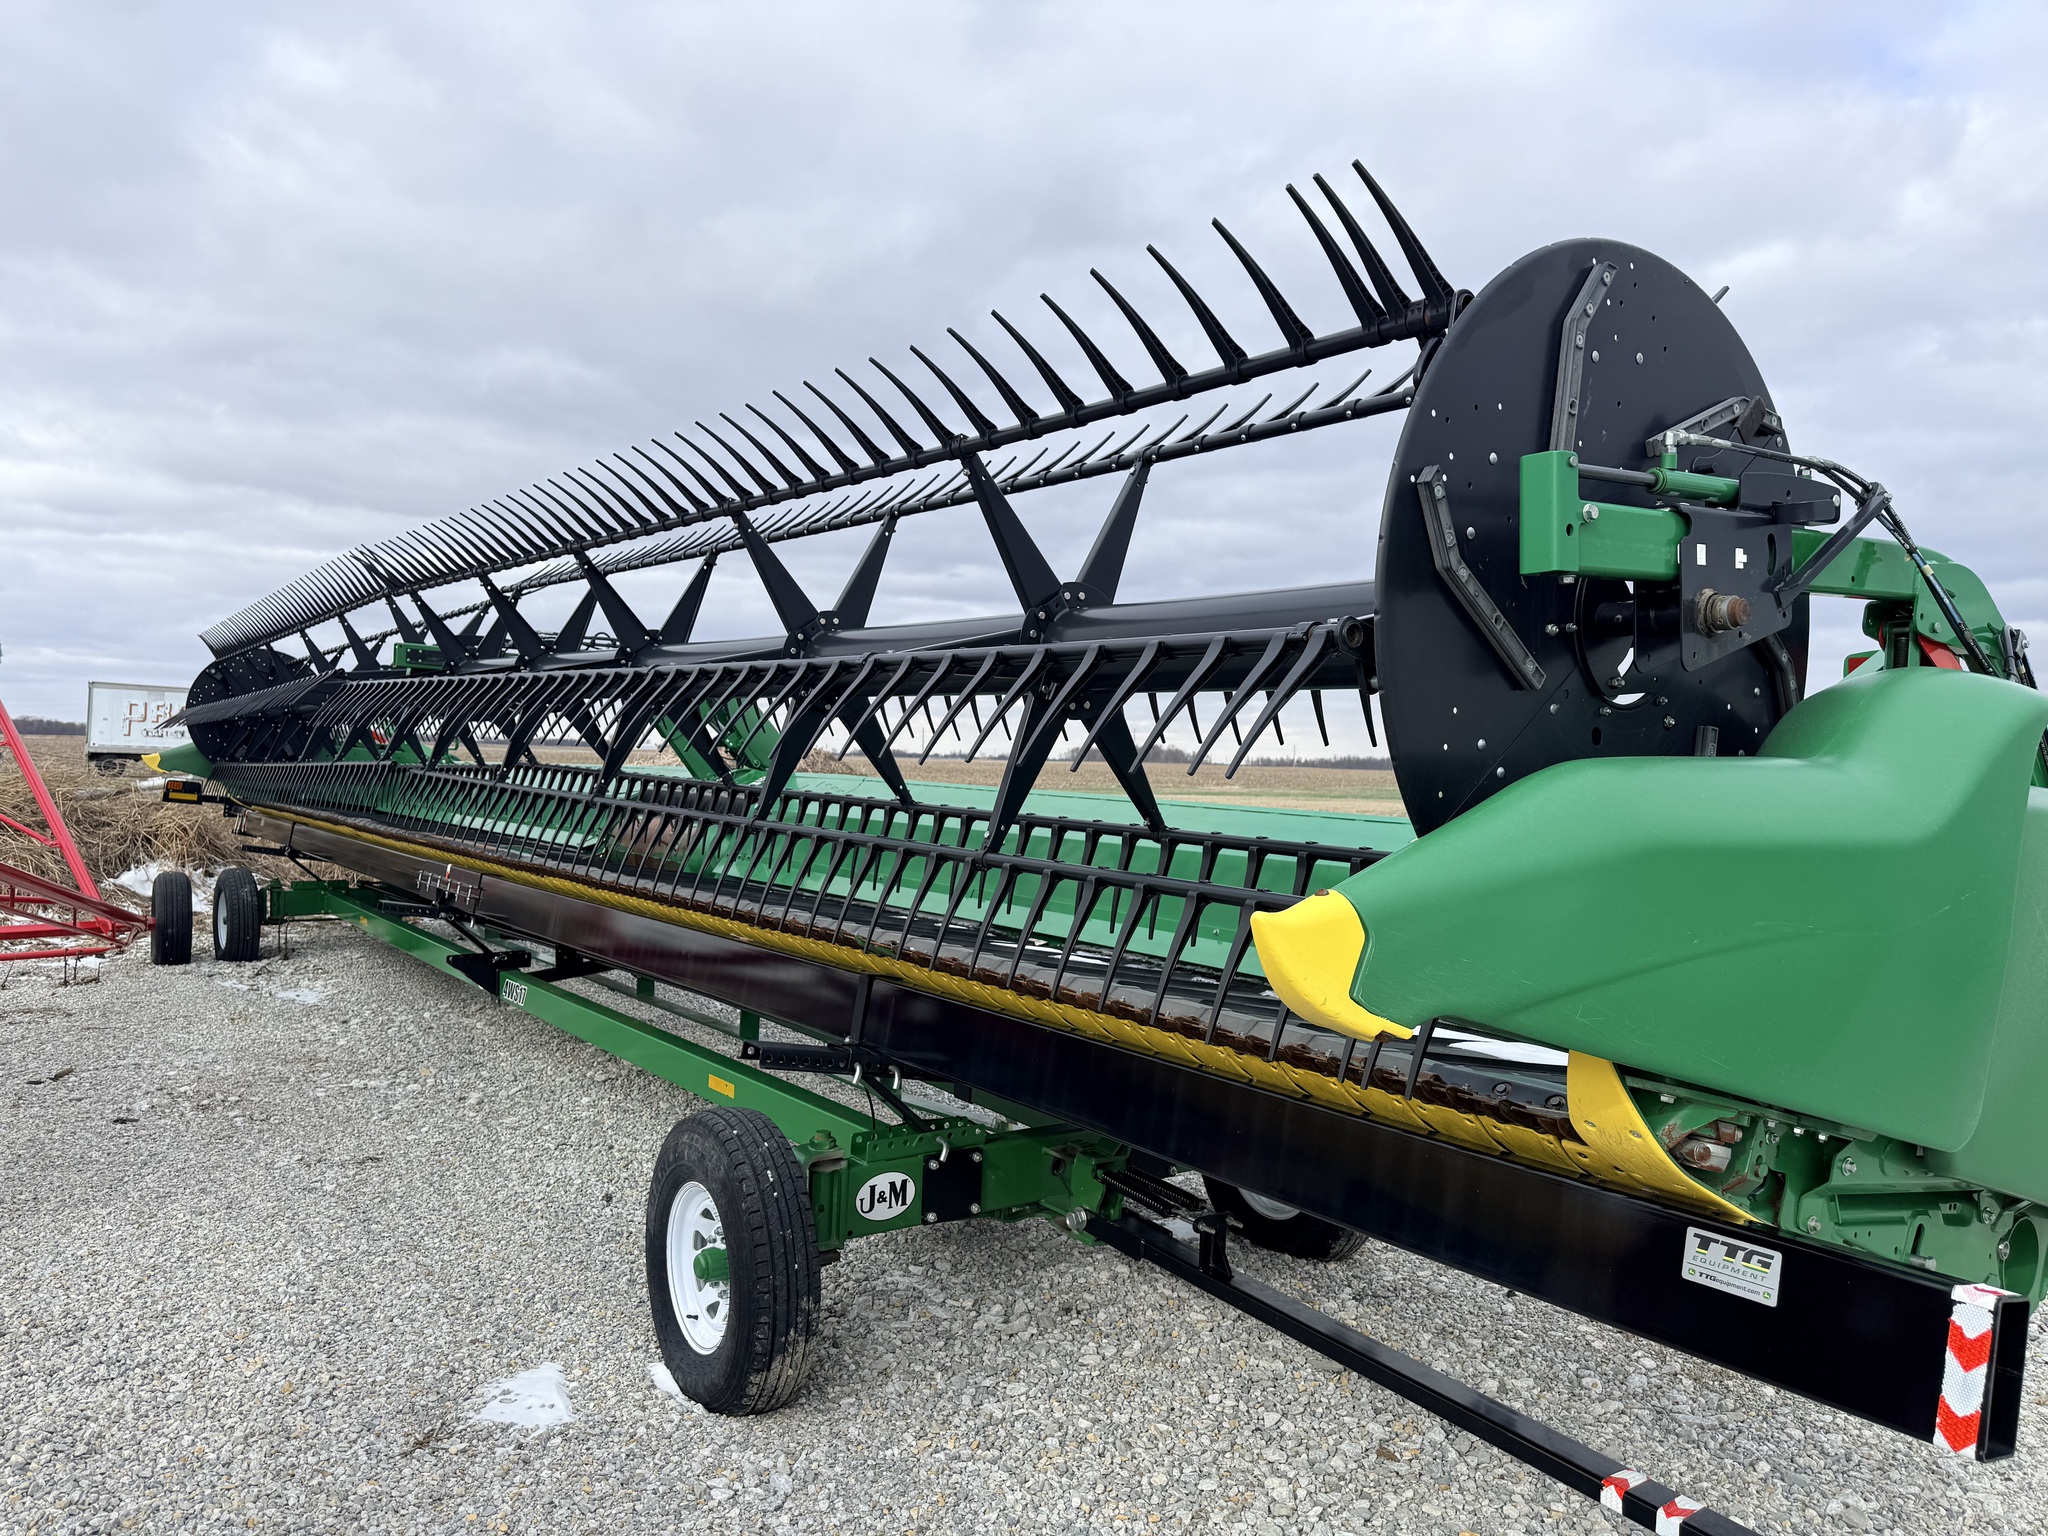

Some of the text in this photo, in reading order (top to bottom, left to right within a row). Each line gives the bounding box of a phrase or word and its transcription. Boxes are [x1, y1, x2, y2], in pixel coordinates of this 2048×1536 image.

[503, 979, 527, 1006] 4WS17
[859, 1178, 908, 1214] J&M
[1693, 1232, 1775, 1275] TTG
[1692, 1255, 1767, 1282] EQUIPMENT
[1698, 1271, 1761, 1296] TTGequipment.com
